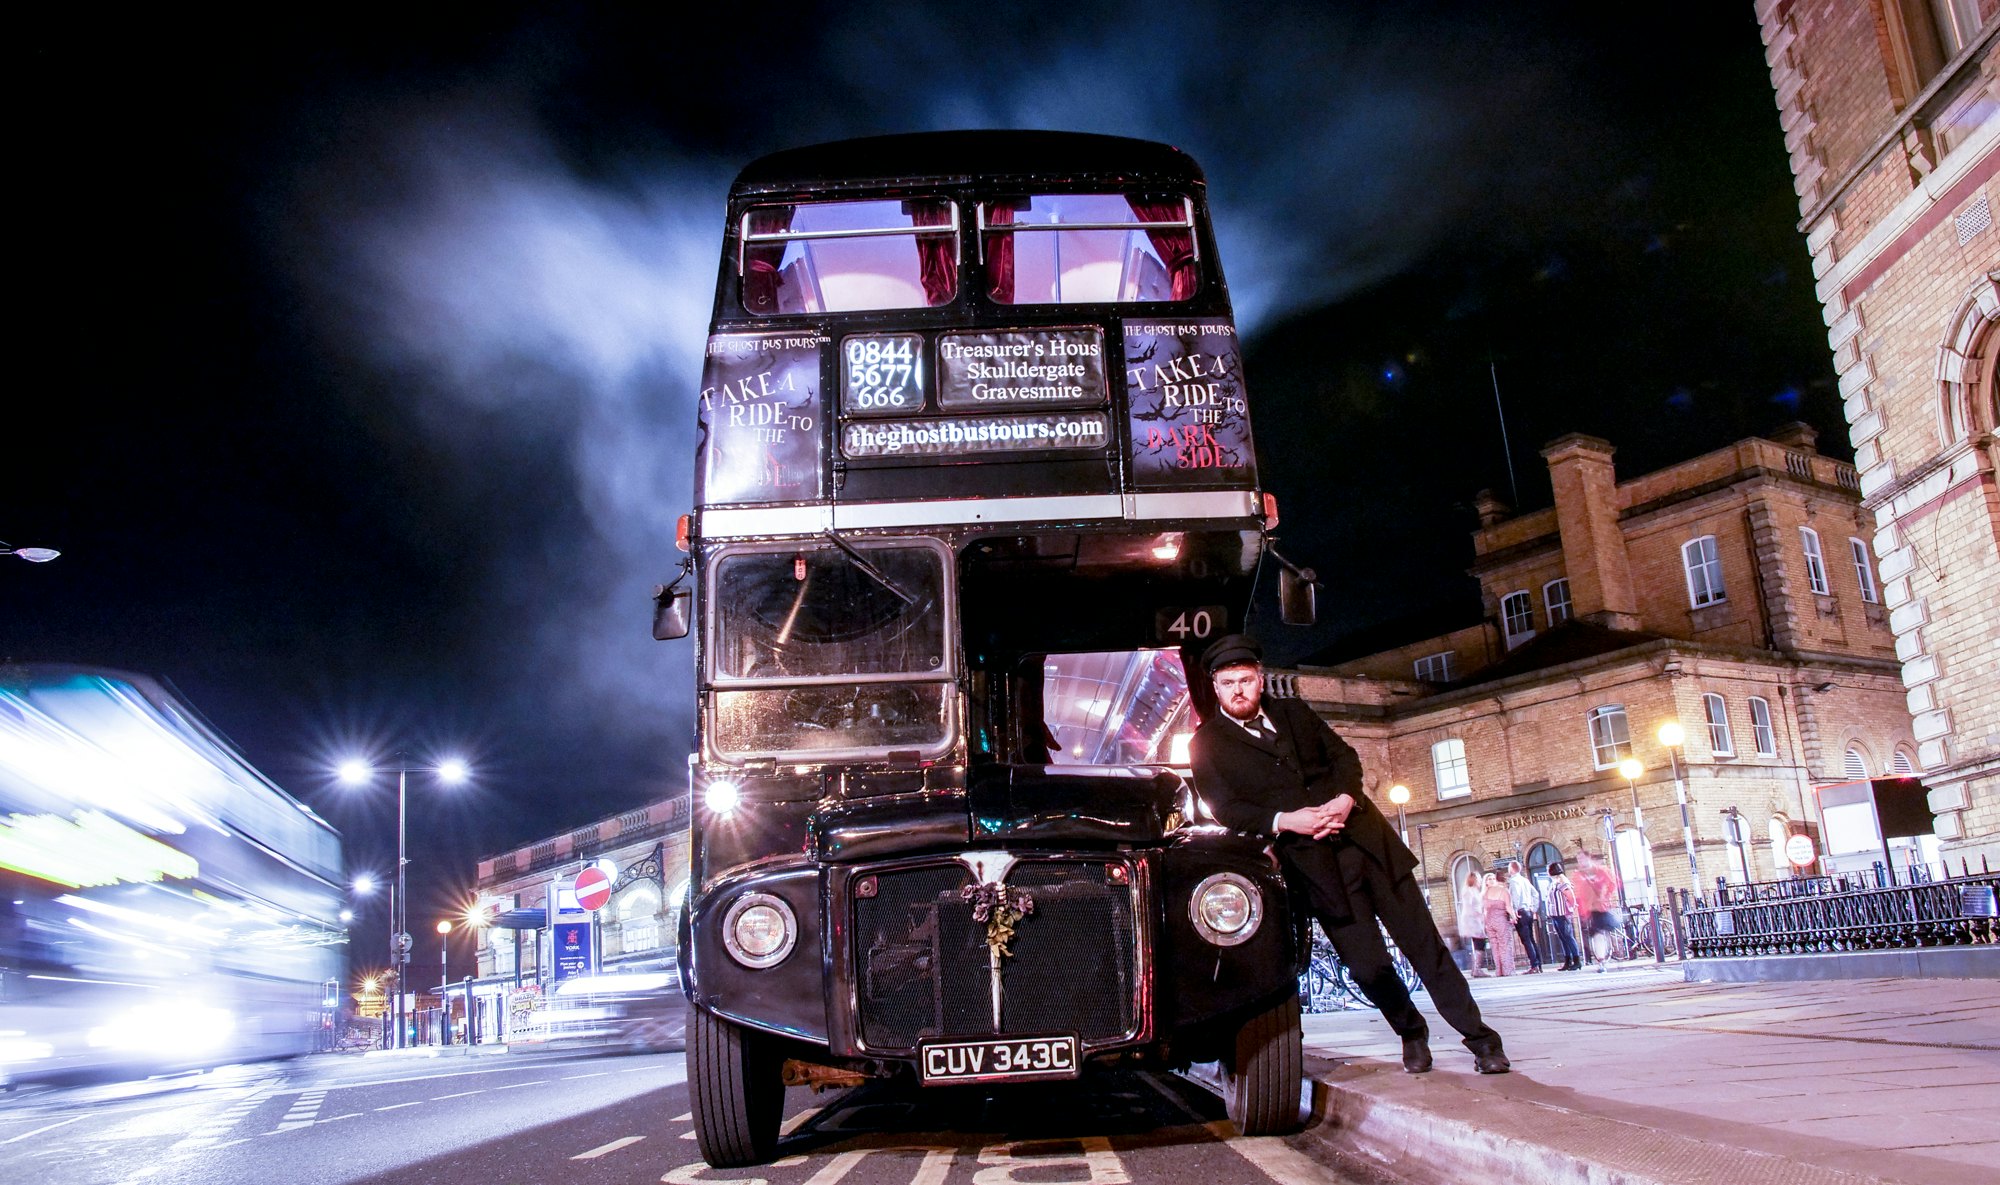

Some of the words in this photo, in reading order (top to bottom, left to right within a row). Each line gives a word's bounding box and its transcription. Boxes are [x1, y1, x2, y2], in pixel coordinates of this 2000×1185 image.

[1124, 325, 1142, 337] THE
[1144, 325, 1176, 336] GHOST
[1178, 325, 1198, 336] BUS
[708, 342, 725, 354] THE
[728, 340, 760, 352] GHOST
[762, 339, 782, 351] BUS
[849, 341, 913, 364] 0844
[941, 340, 1045, 360] Treasurer's
[1049, 339, 1101, 357] Hous
[850, 364, 913, 387] 5677
[967, 362, 1086, 381] Skulldergate
[1126, 353, 1207, 391] TAKE
[1210, 355, 1227, 374] A
[699, 371, 776, 412] TAKE
[779, 372, 796, 391] A
[858, 386, 905, 408] 666
[972, 382, 1083, 400] Gravesmire
[1163, 383, 1223, 408] RIDE
[1222, 396, 1246, 413] TO
[729, 401, 788, 428] RIDE
[787, 415, 813, 432] TO
[1189, 408, 1223, 424] THE
[753, 428, 787, 443] THE
[850, 419, 1104, 451] theghostbustours.com
[1147, 423, 1220, 449] DARK
[1167, 610, 1212, 640] 40
[1483, 823, 1500, 834] THE
[1501, 814, 1537, 831] DUKE
[1550, 806, 1587, 820] YORK
[928, 1046, 985, 1075] CUV
[993, 1041, 1070, 1071] 343C
